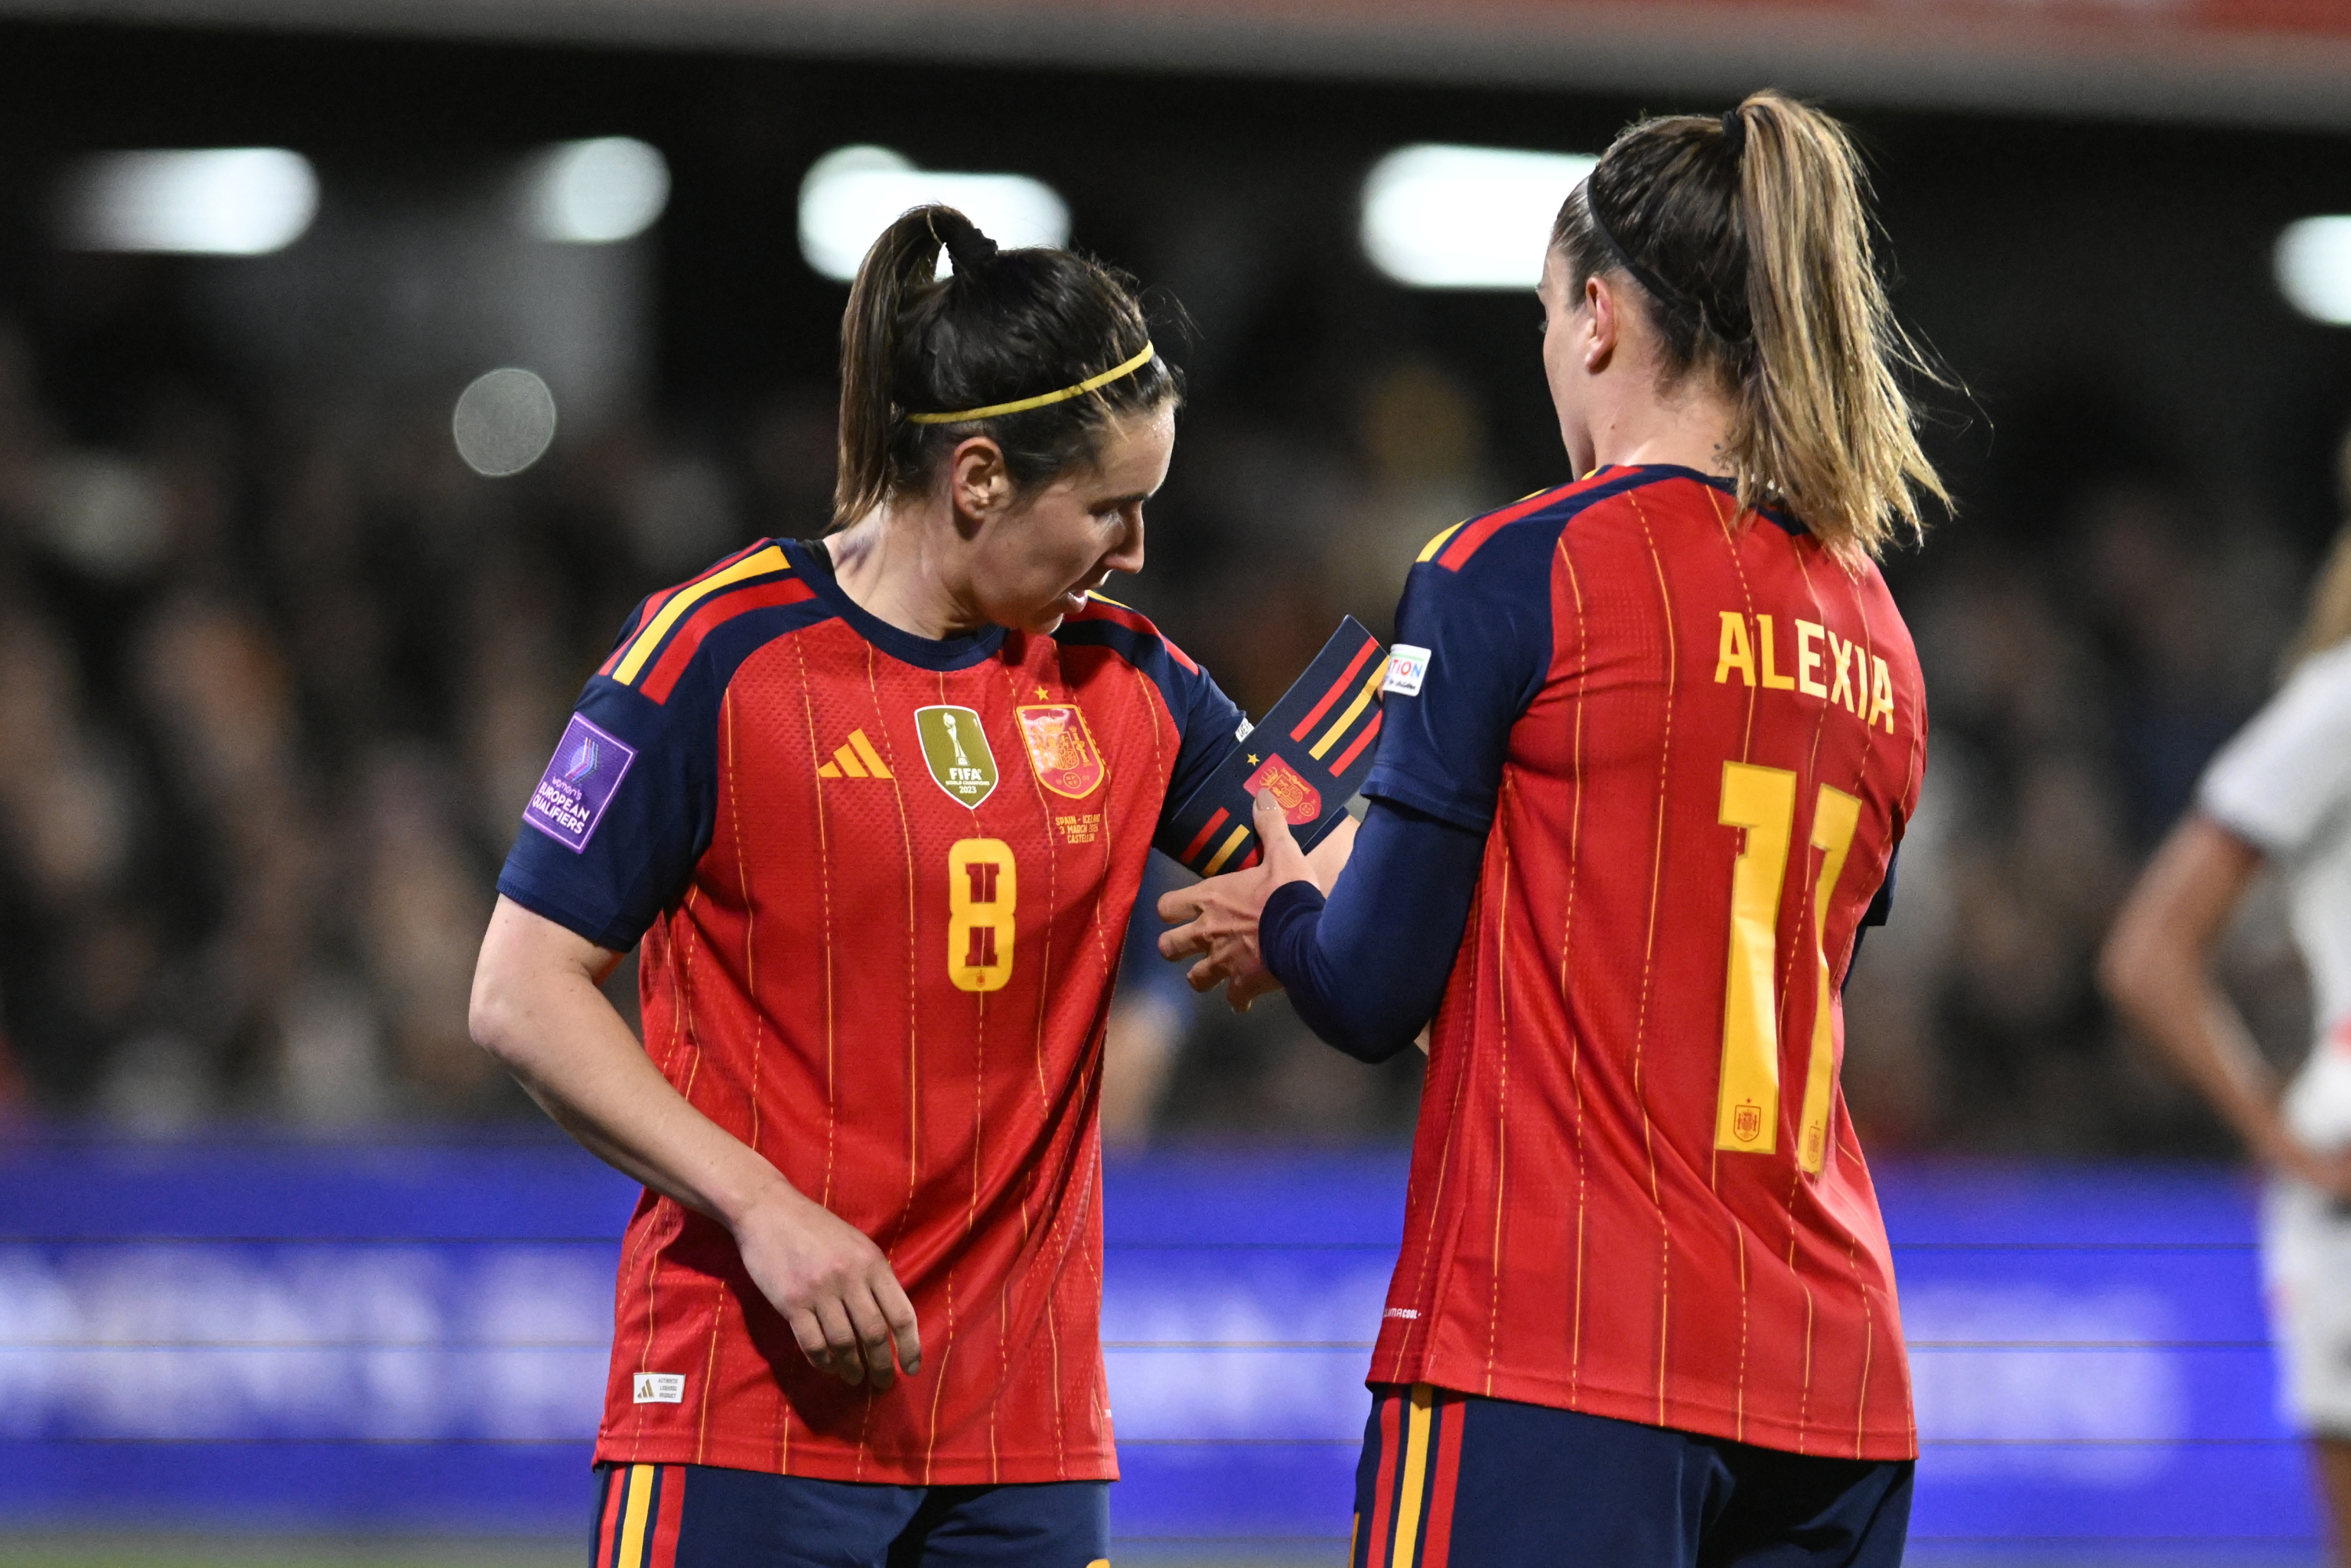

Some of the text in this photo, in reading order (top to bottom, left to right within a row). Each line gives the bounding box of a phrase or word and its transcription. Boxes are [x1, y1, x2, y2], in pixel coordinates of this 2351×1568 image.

[1714, 611, 1894, 735] ALEXIA
[532, 794, 585, 834] QUALIFIERS
[539, 782, 590, 822] EUROPEAN
[1055, 815, 1077, 826] SPAIN
[1059, 826, 1065, 835] 3
[1067, 824, 1088, 834] MARCH
[948, 838, 1017, 992] 8
[1714, 760, 1862, 1174] 11
